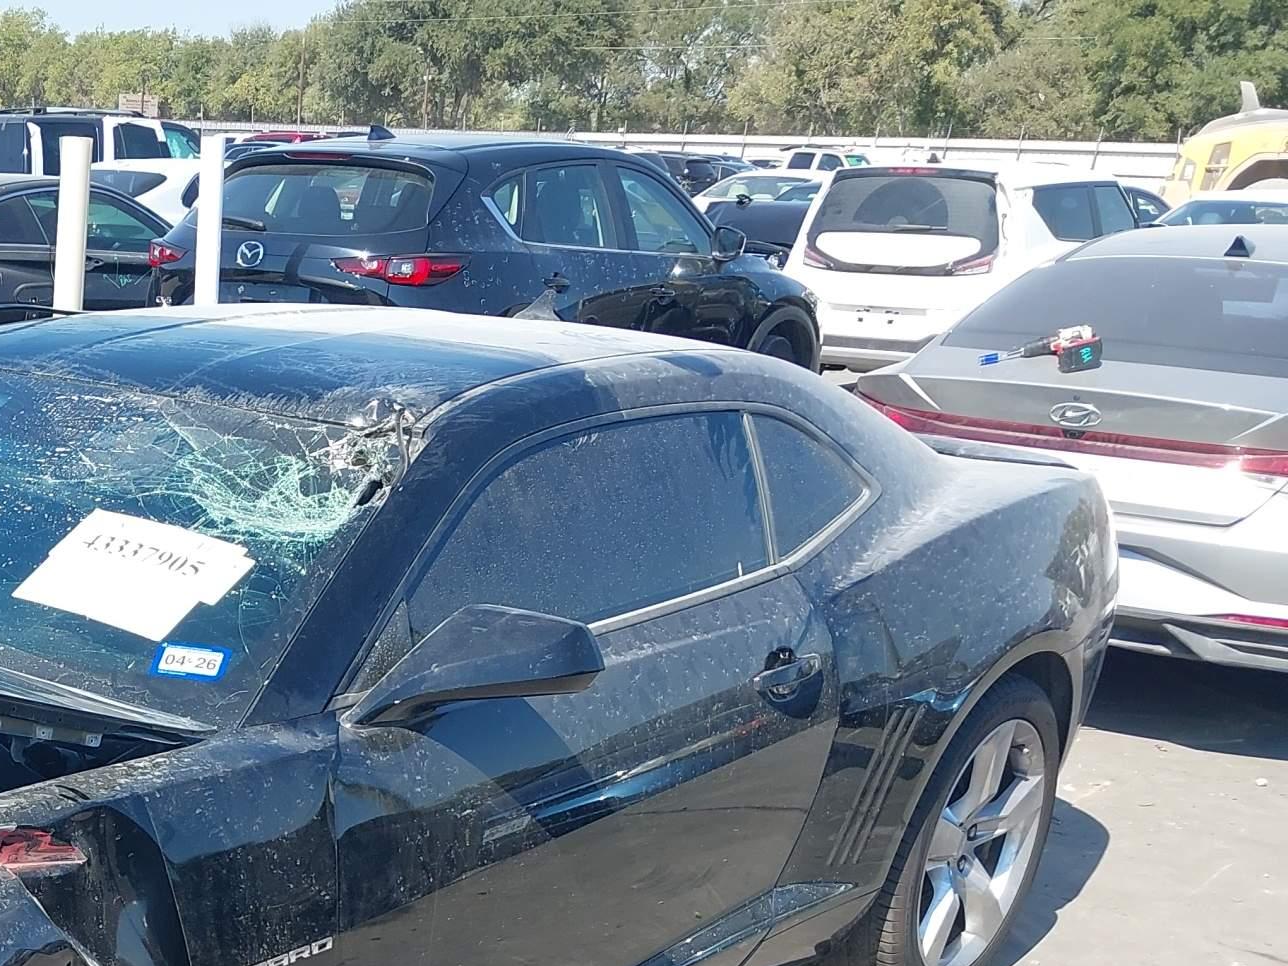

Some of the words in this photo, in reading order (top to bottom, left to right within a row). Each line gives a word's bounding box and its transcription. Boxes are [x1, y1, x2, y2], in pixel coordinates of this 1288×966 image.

[83, 534, 206, 575] 43337905
[165, 654, 186, 666] 04
[195, 657, 218, 670] 26
